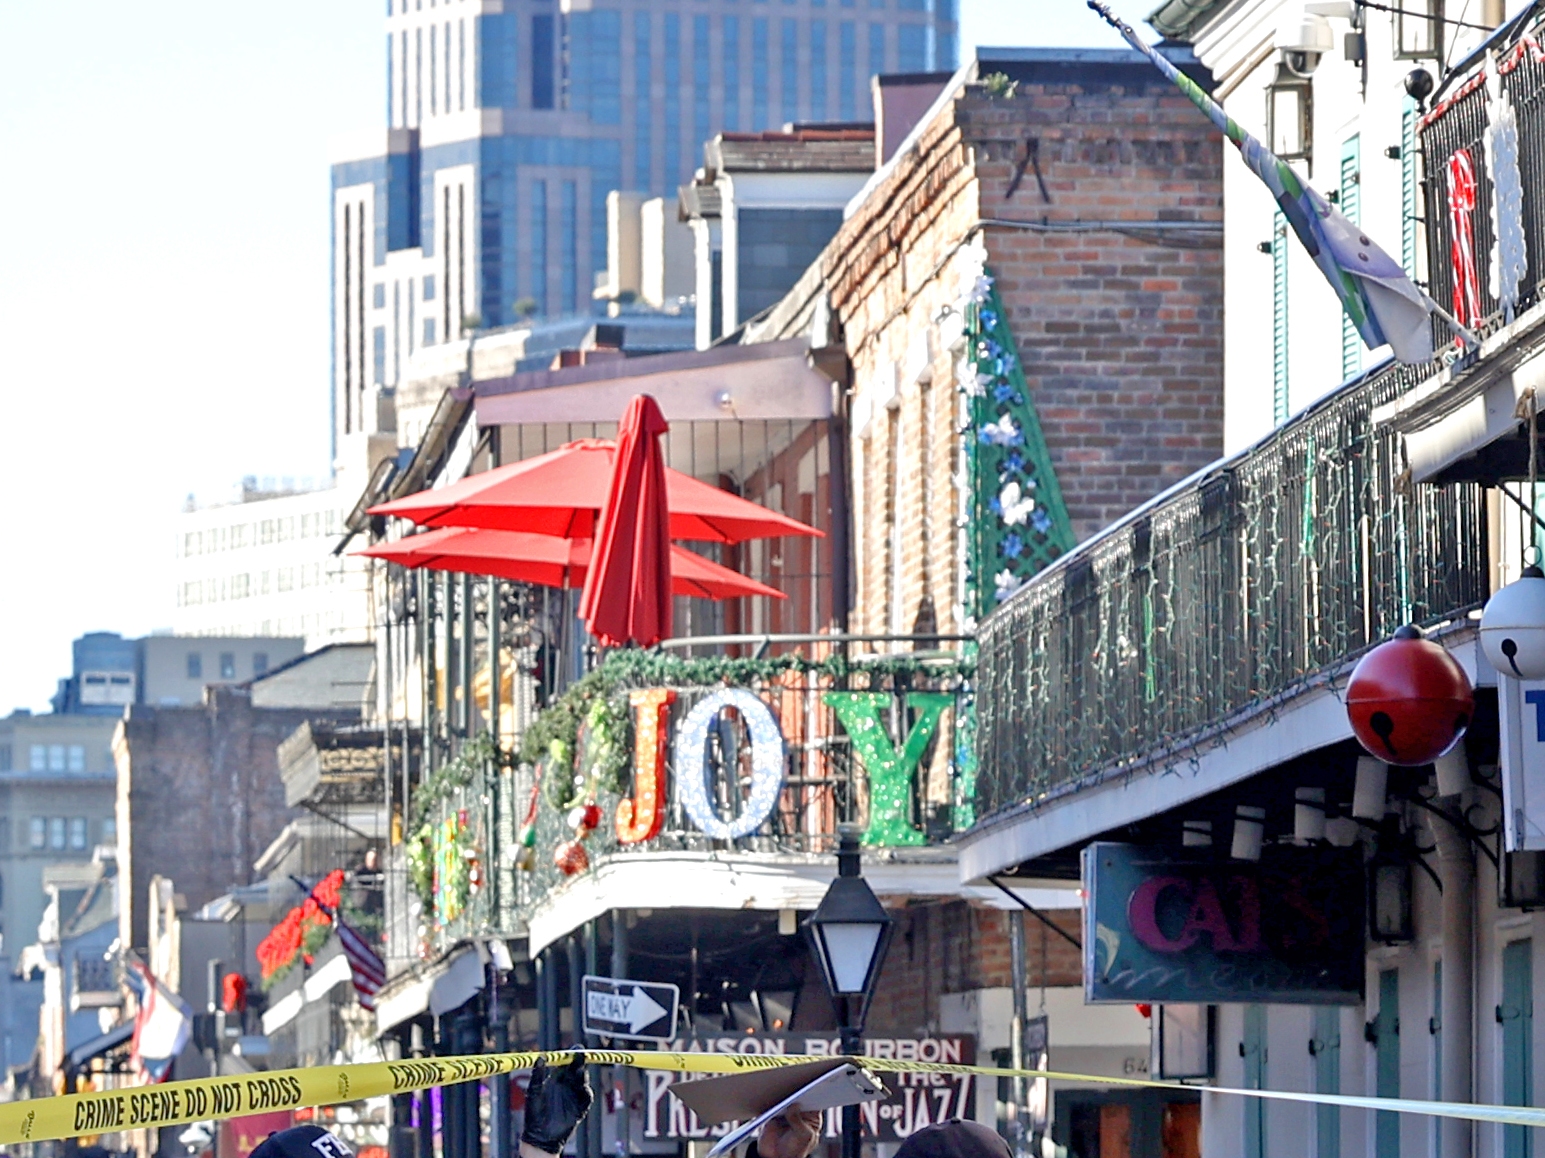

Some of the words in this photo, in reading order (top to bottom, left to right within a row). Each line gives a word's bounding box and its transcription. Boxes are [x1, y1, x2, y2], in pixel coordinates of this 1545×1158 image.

[616, 687, 956, 846] JOY
[608, 998, 631, 1019] WAY
[388, 1062, 445, 1089] CRIME
[73, 1099, 125, 1131] CRIME
[130, 1090, 180, 1125] SCENE
[184, 1086, 207, 1117] DO
[210, 1082, 243, 1114] NOT
[248, 1076, 303, 1109] CROSS
